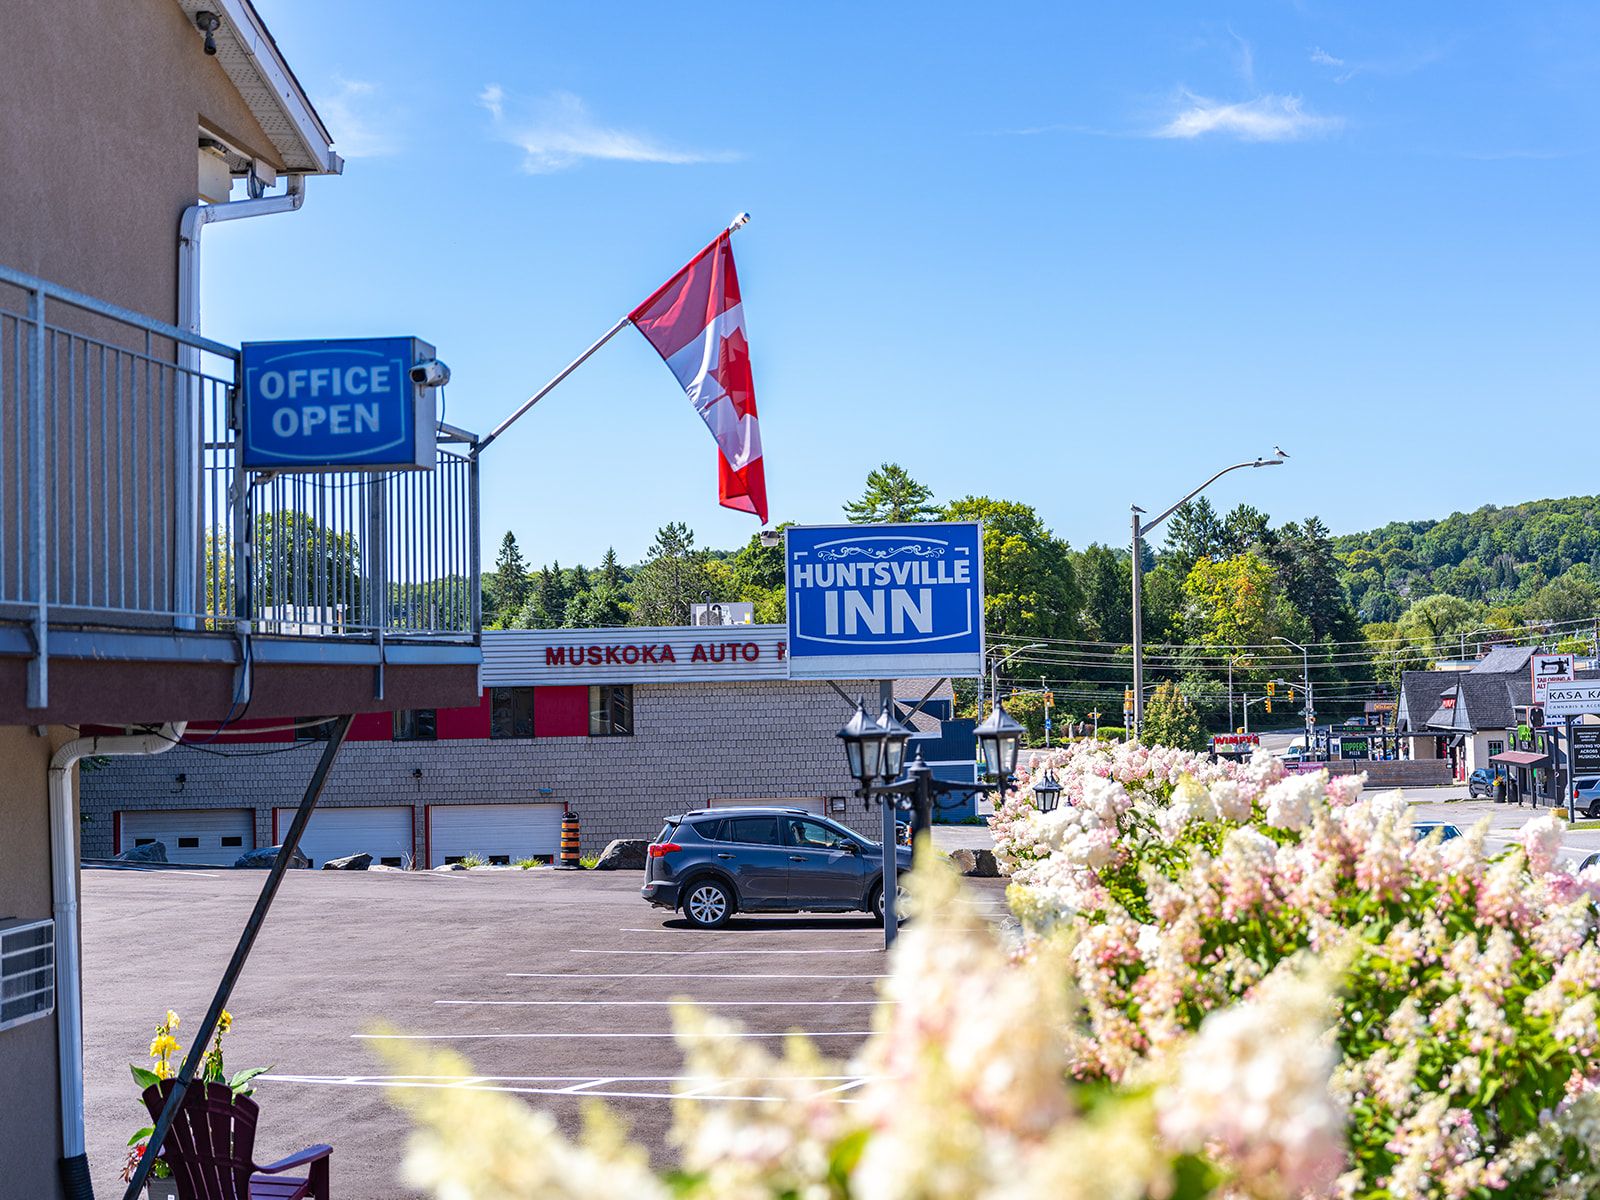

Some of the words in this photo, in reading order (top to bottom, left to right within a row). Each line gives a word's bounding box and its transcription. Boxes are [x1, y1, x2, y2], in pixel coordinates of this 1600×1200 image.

[259, 365, 391, 400] OFFICE
[272, 402, 380, 437] OPEN
[793, 559, 971, 588] HUNTSVILLE
[825, 588, 933, 635] INN
[545, 644, 676, 666] MUSKOKA
[691, 642, 759, 663] AUTO
[1549, 691, 1582, 700] KASA
[1342, 741, 1367, 751] TOPPER'S
